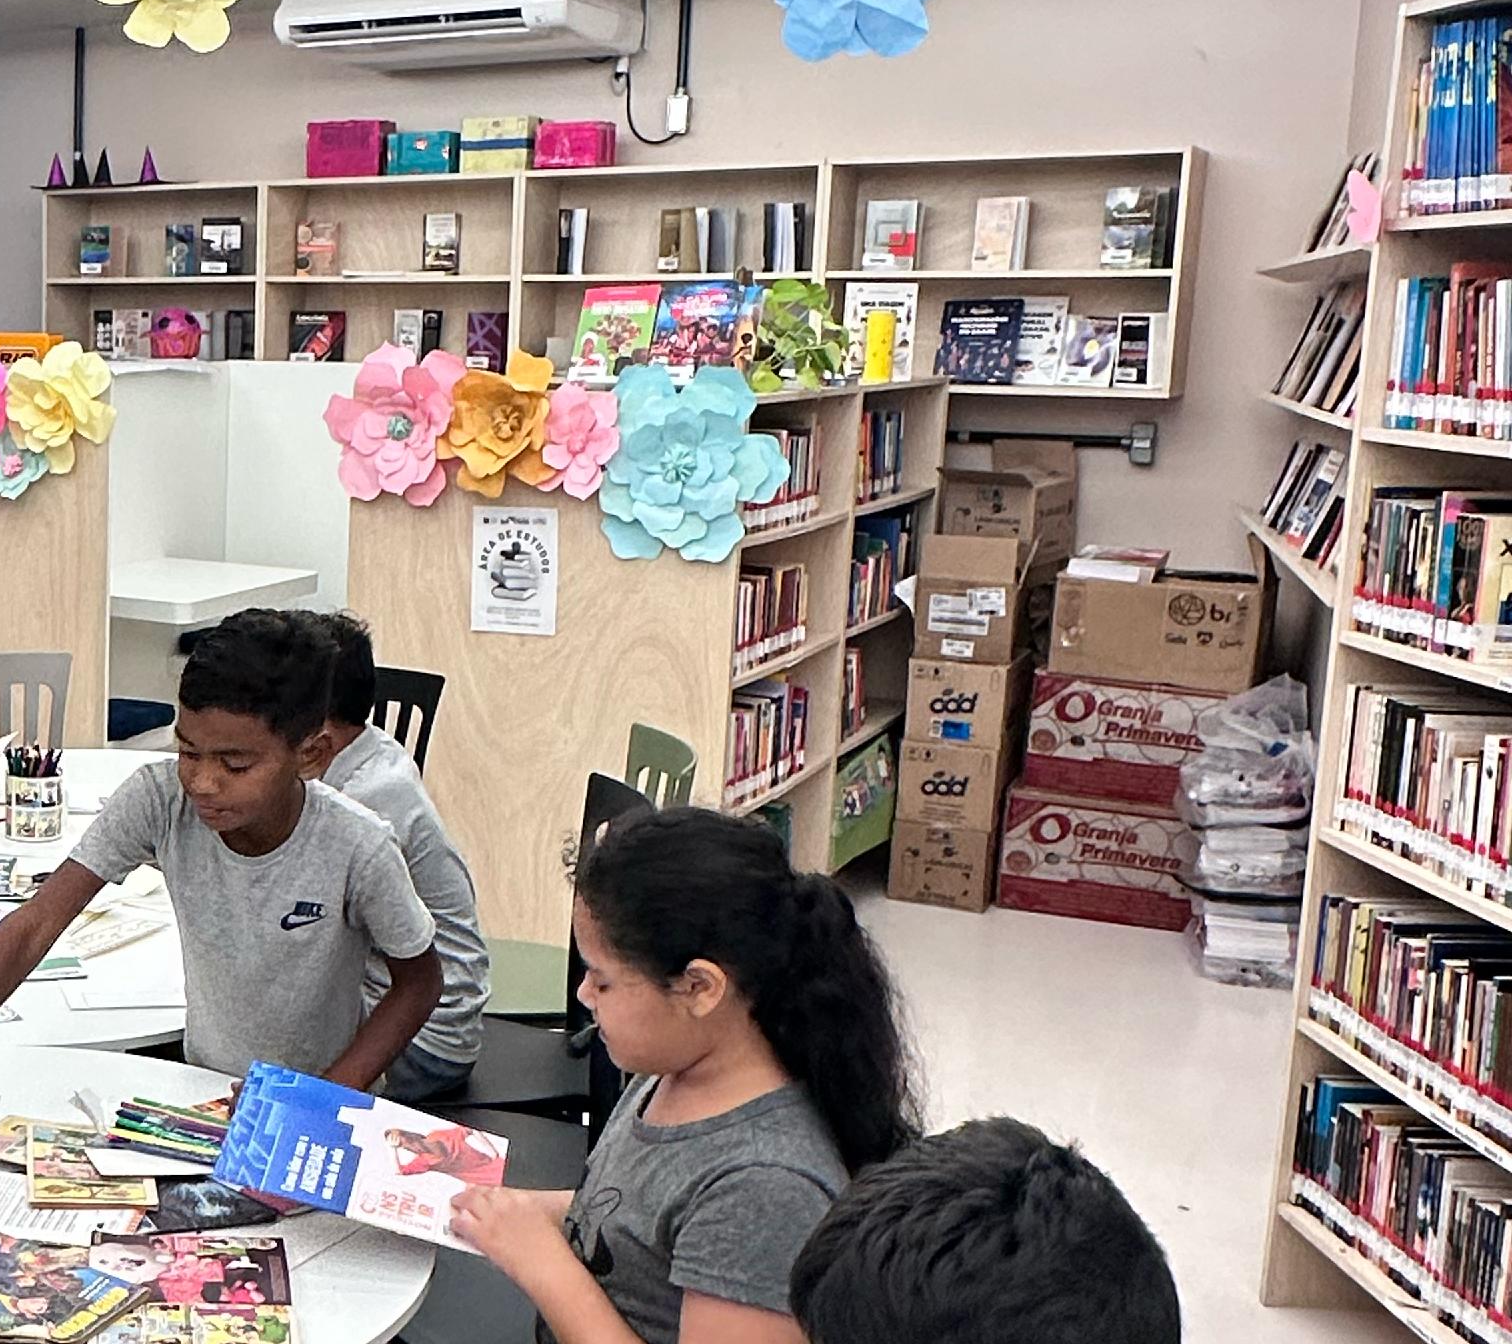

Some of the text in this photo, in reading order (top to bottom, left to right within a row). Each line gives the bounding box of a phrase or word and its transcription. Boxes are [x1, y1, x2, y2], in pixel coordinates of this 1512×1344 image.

[498, 530, 512, 541] DE
[516, 530, 550, 574] ESTUDOS
[1096, 700, 1164, 725] Granja
[1072, 822, 1139, 847] Granja
[1079, 842, 1183, 870] Primavera
